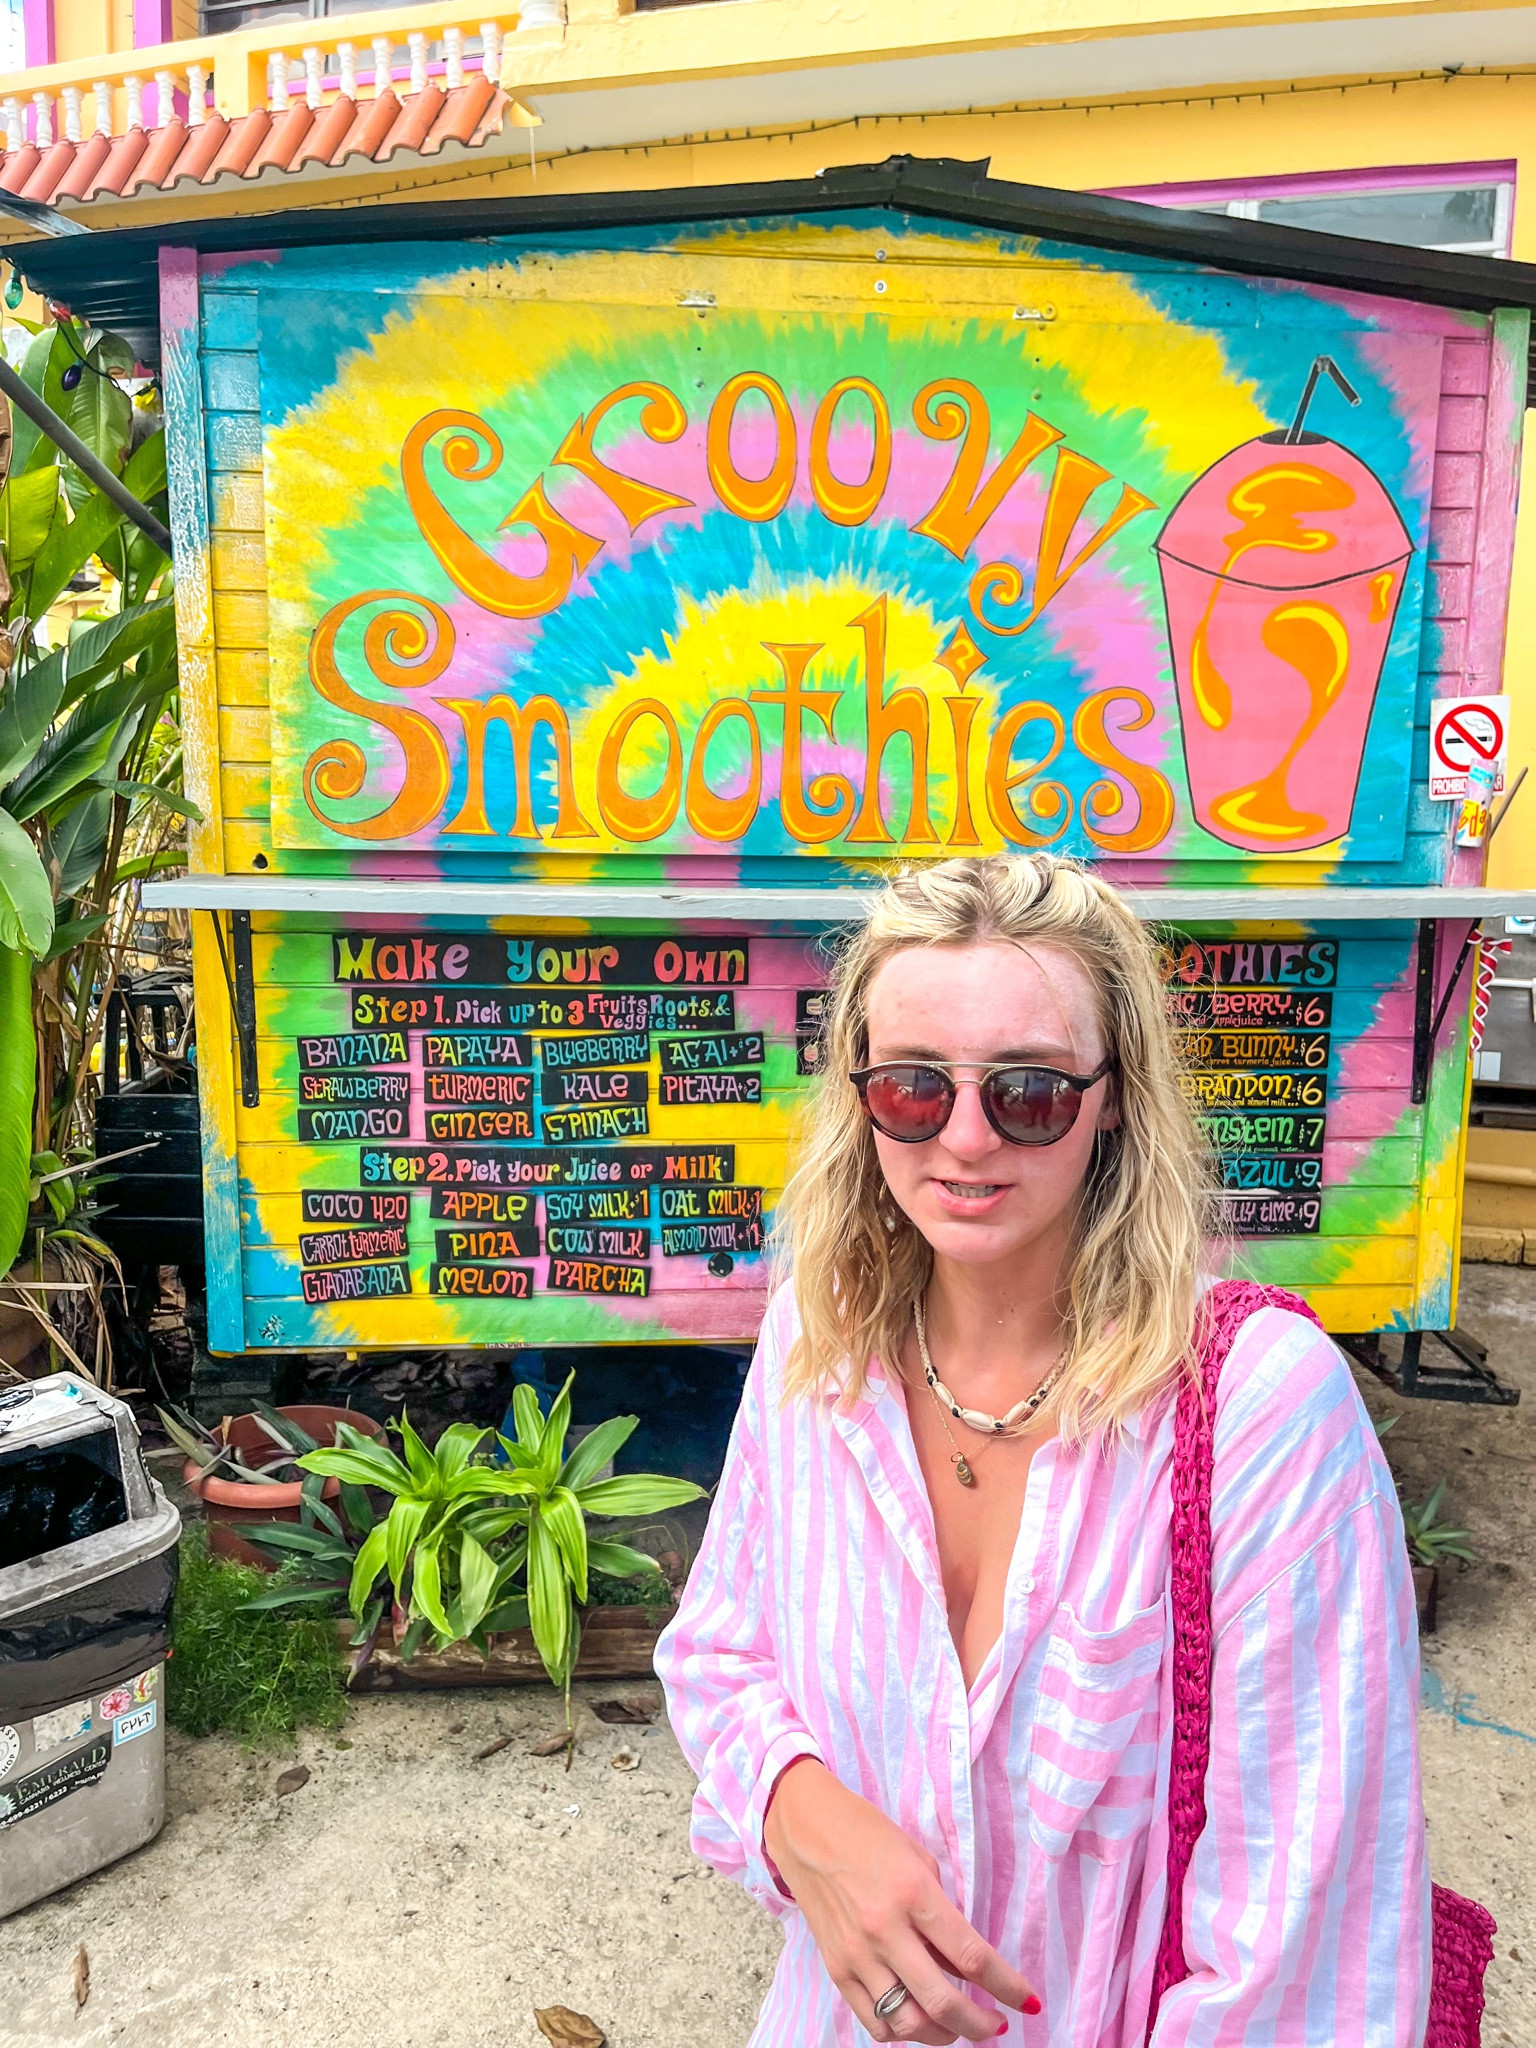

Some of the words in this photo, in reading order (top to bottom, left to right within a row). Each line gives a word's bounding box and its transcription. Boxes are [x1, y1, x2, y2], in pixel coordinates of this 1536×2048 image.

[400, 371, 1159, 635] Groovy
[302, 591, 1175, 853] Smoothies
[1433, 779, 1468, 794] PROHIBID
[336, 937, 470, 981] Make
[505, 939, 619, 983] Your
[653, 941, 746, 983] Own
[1151, 942, 1336, 986] OOTHIES
[354, 994, 427, 1024] Step
[509, 1004, 535, 1024] up
[537, 1000, 563, 1024] to
[567, 1000, 585, 1025] 3
[714, 994, 731, 1016] &
[1208, 993, 1292, 1017] BERRY
[301, 1032, 408, 1067] BANANA
[425, 1036, 522, 1067] PAPAYA
[544, 1035, 649, 1067] BLUEBERRY
[1220, 1035, 1296, 1058] BUNNY
[302, 1076, 408, 1102] STRAWBERRY
[428, 1074, 531, 1105] TURMERIC
[561, 1073, 630, 1100] KALE
[1176, 1074, 1293, 1100] BRANDON
[311, 1108, 403, 1140] MANGO
[430, 1111, 533, 1138] GINGER
[545, 1106, 647, 1141] SPINACH
[363, 1152, 425, 1182] Step
[507, 1161, 560, 1183] your
[564, 1157, 622, 1182] Juice
[630, 1163, 653, 1180] or
[1221, 1159, 1295, 1188] AZUL
[307, 1194, 363, 1218] COCO
[442, 1191, 528, 1221] APPLE
[546, 1193, 584, 1220] SOY
[662, 1189, 700, 1218] OAT
[1260, 1200, 1295, 1222] TIME
[301, 1233, 349, 1264] CARROT
[348, 1226, 406, 1258] TURMERIC
[548, 1227, 594, 1254] COW
[599, 1228, 645, 1258] MILK
[663, 1225, 708, 1256] ALMOND
[709, 1222, 739, 1251] MILK
[303, 1264, 407, 1302] GUANABANA
[438, 1266, 528, 1298] MELON
[553, 1259, 646, 1297] PARCHA
